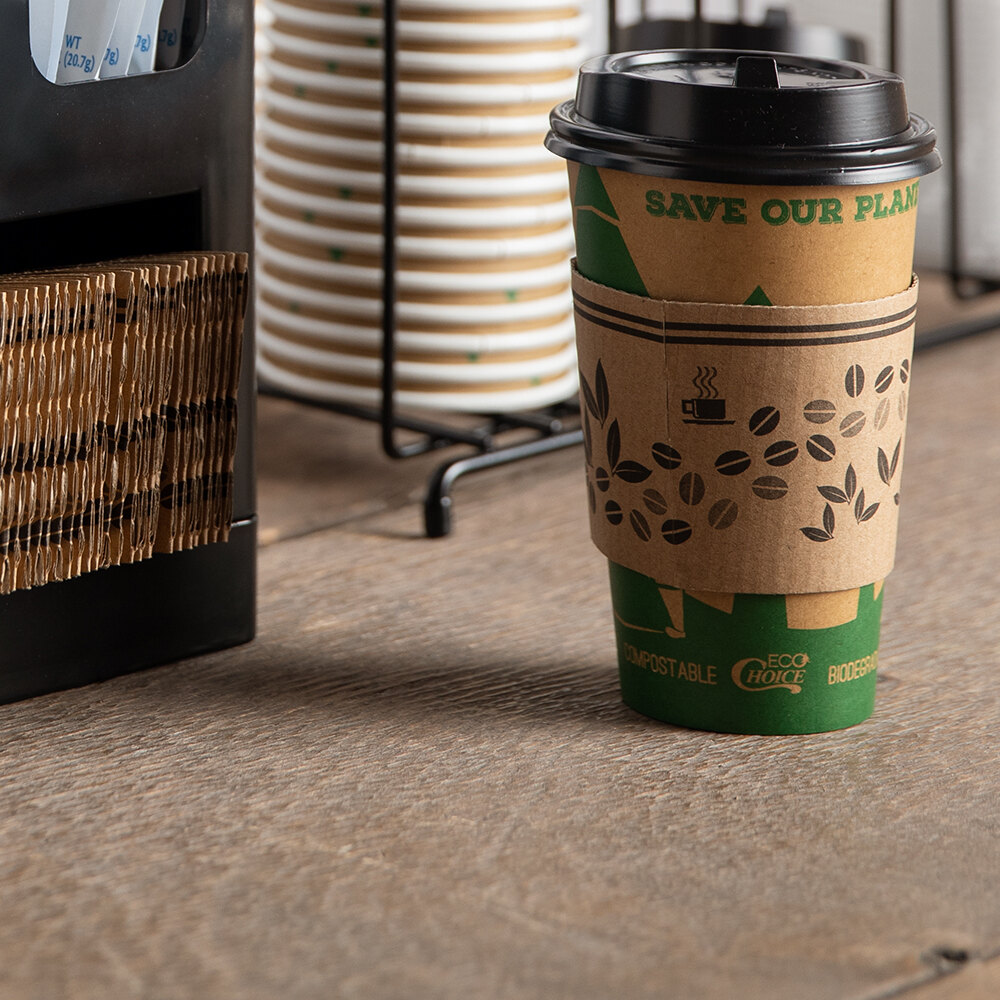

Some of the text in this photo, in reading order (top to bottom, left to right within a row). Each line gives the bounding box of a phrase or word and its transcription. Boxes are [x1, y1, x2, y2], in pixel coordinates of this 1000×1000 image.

[65, 34, 82, 50] WT
[63, 52, 95, 73] (20.7g)
[645, 189, 747, 224] SAVE
[760, 197, 843, 226] OUR
[623, 642, 717, 685] COMPOSTABLE
[767, 653, 809, 668] ECO
[731, 657, 806, 694] CHOICE
